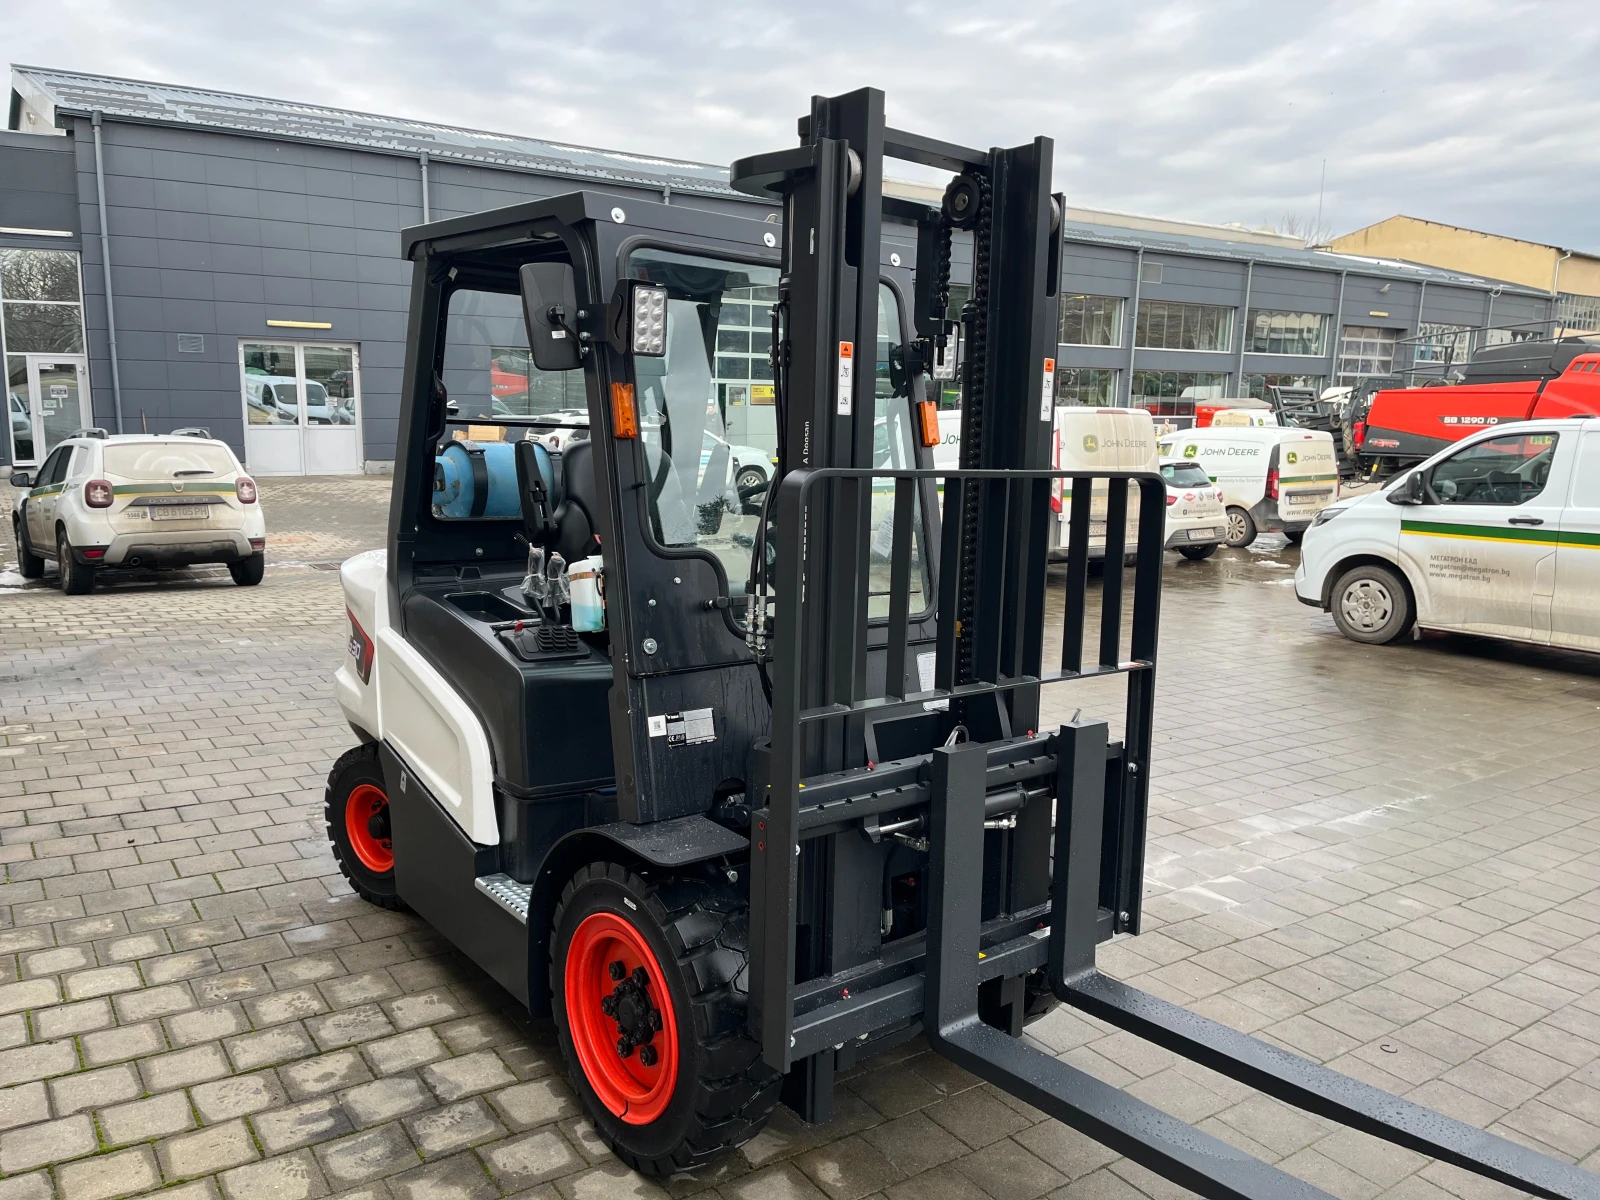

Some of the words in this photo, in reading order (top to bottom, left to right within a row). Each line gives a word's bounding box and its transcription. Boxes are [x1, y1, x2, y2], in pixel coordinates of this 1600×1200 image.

[1460, 416, 1485, 424] 1290
[802, 420, 810, 456] Doosan
[1101, 437, 1124, 448] JOHN
[1124, 438, 1148, 448] DEERE
[1200, 446, 1227, 456] JOHN
[1227, 447, 1260, 456] DEERE
[802, 457, 809, 465] A
[1301, 454, 1317, 462] JOHN
[1317, 453, 1333, 461] DEERE
[156, 506, 169, 517] CB
[171, 505, 193, 517] 8105
[194, 505, 207, 516] PH
[1430, 555, 1464, 563] МЕГАТРОН
[1429, 563, 1511, 577] megatron@megatron.bg
[1429, 572, 1491, 583] www.megatron.bg
